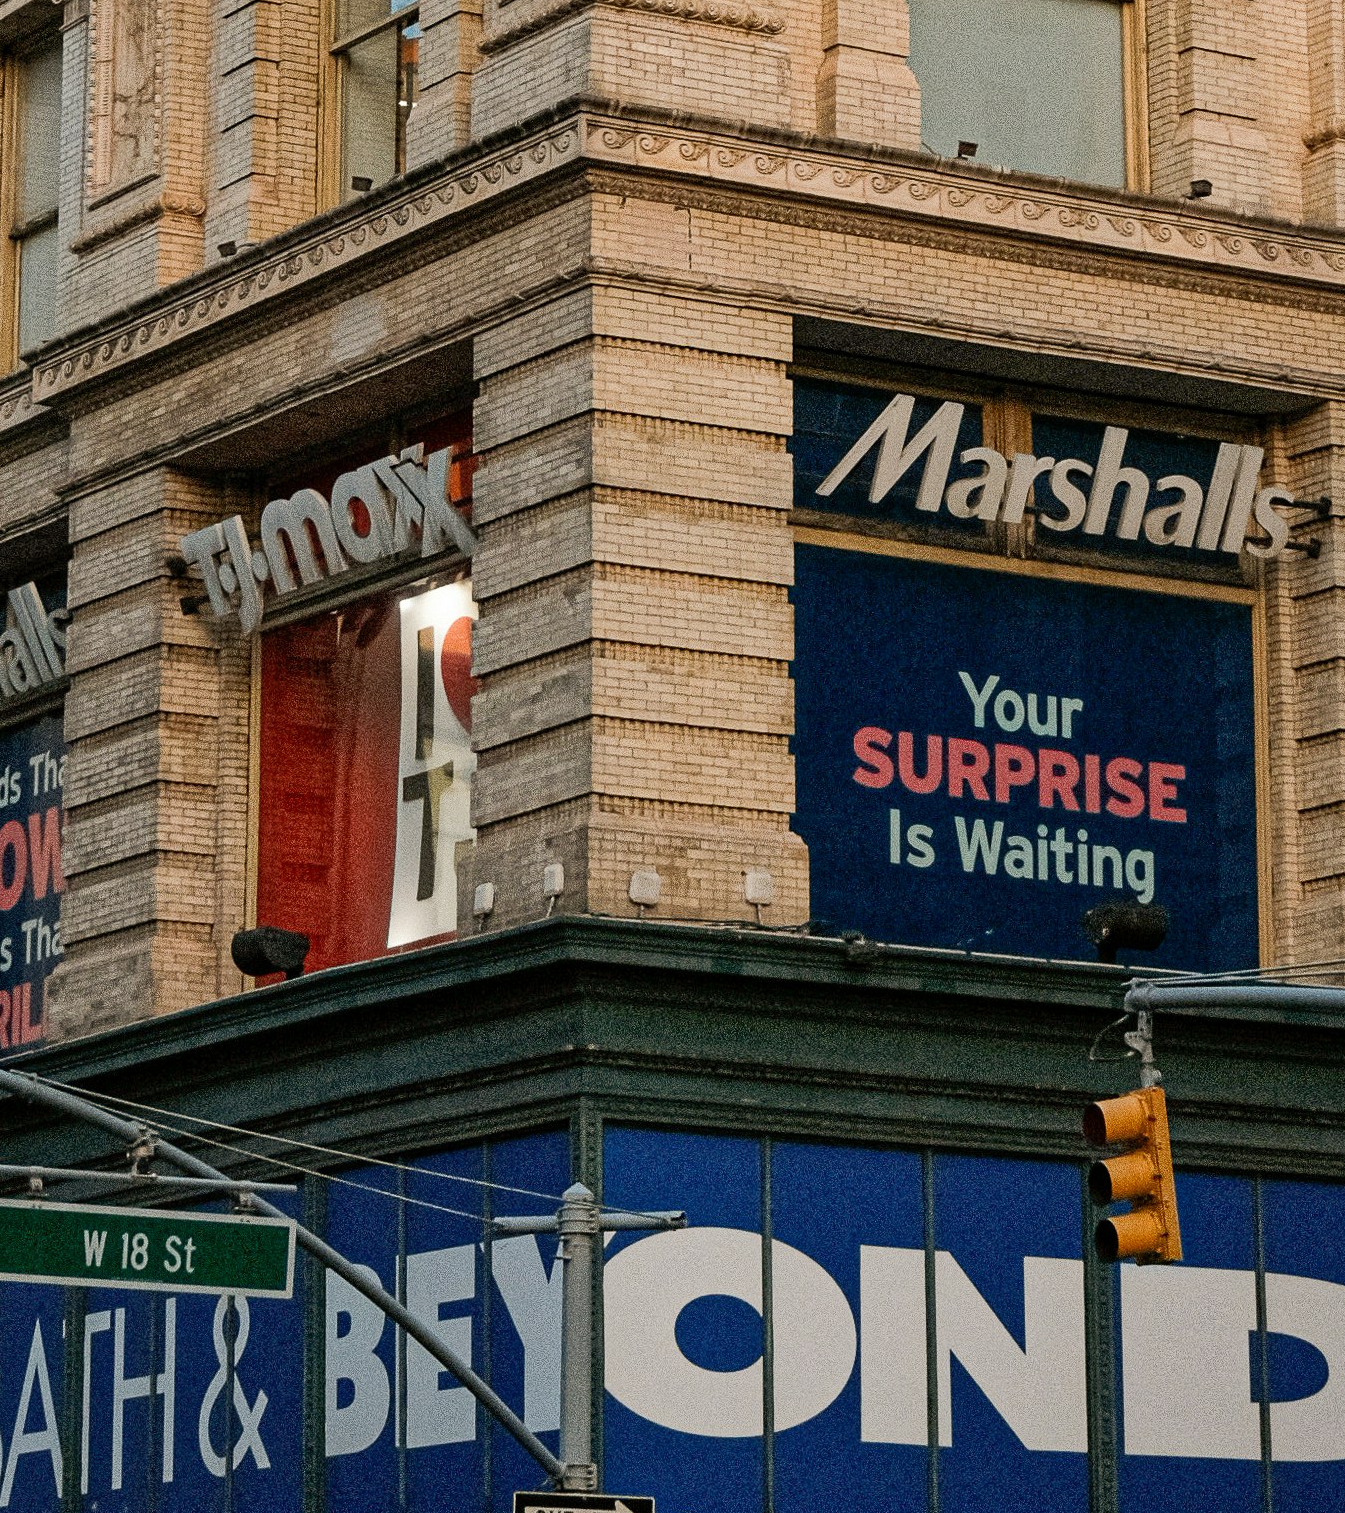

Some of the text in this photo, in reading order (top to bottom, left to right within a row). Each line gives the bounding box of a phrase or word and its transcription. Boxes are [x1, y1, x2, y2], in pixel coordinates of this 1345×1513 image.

[814, 392, 1295, 559] Marshalls
[958, 670, 1084, 739] Your
[29, 750, 68, 797] Tha
[851, 725, 1187, 824] SURPRISE
[889, 808, 1156, 905] Is Waiting
[21, 916, 65, 966] Tha
[83, 1229, 197, 1274] W 18 St
[197, 1292, 272, 1480] &
